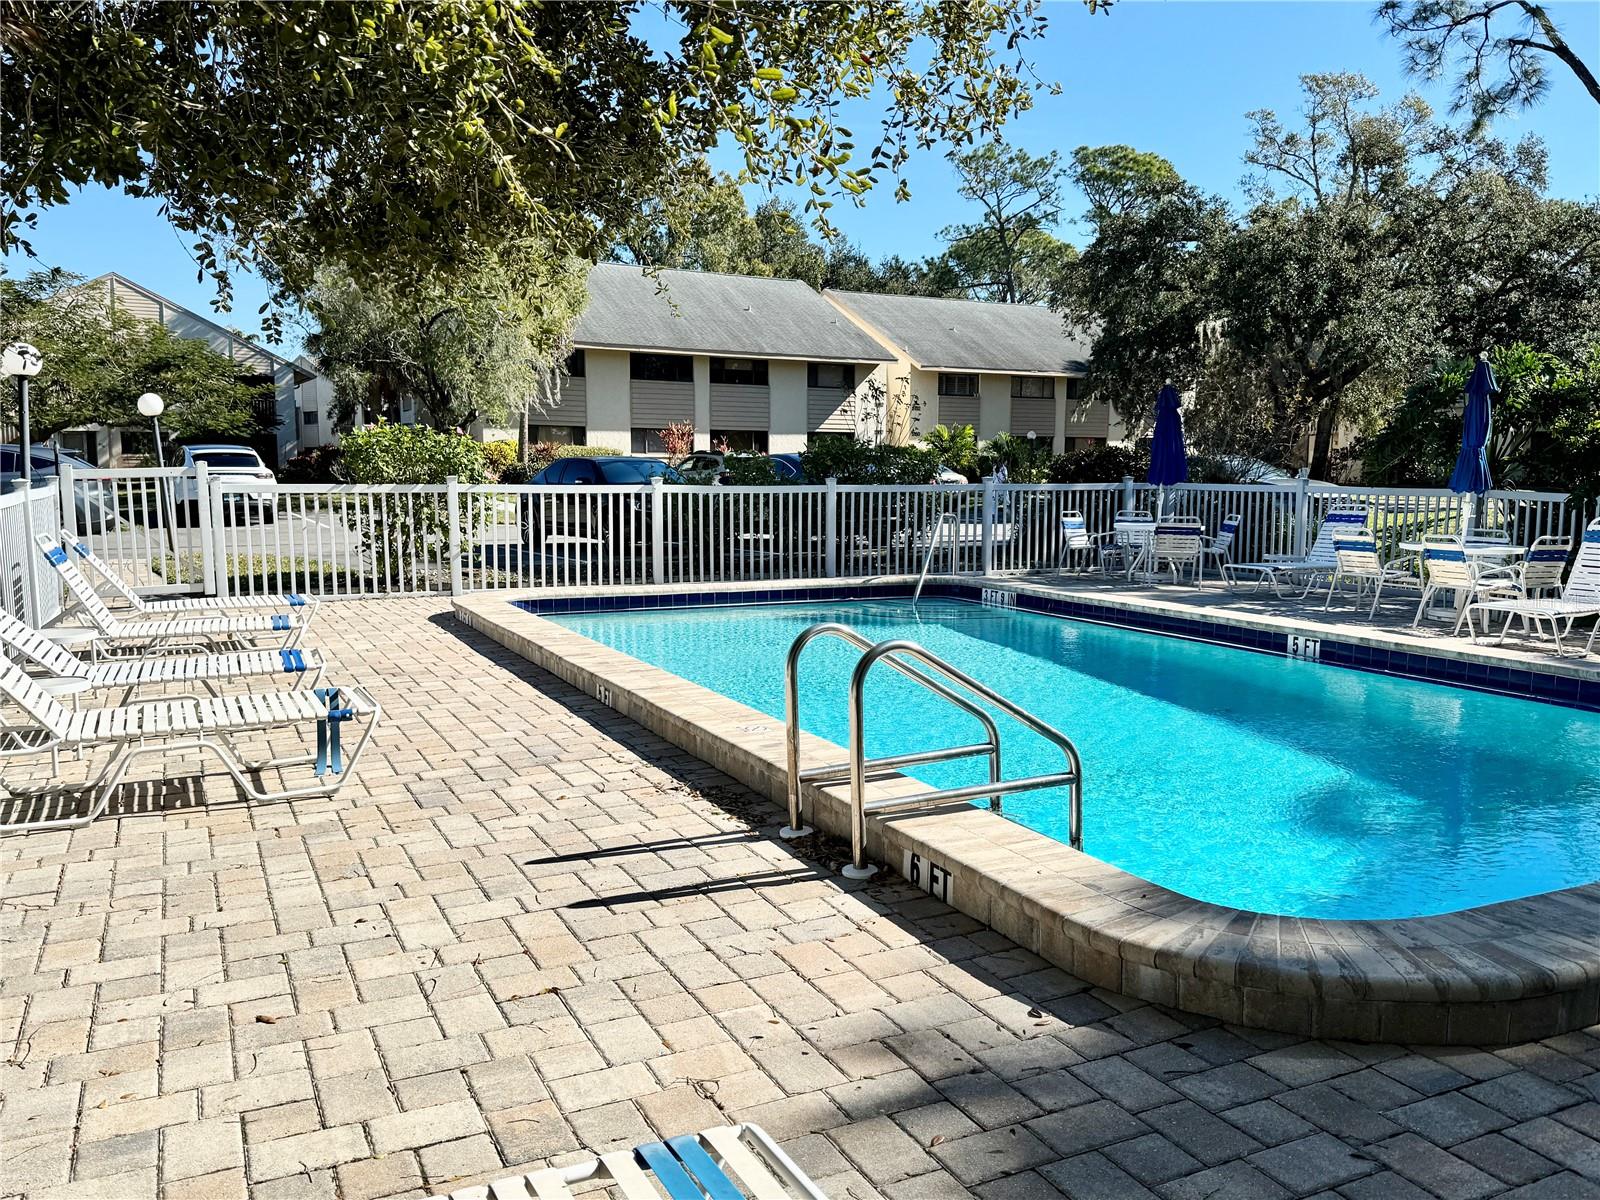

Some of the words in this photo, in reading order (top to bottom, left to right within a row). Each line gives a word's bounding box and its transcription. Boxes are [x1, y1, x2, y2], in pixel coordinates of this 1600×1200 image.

[990, 590, 999, 604] FT
[1008, 593, 1016, 606] IN
[1292, 636, 1299, 655] 5
[1304, 638, 1319, 658] FT
[910, 852, 921, 887] 6
[929, 862, 953, 904] FT
